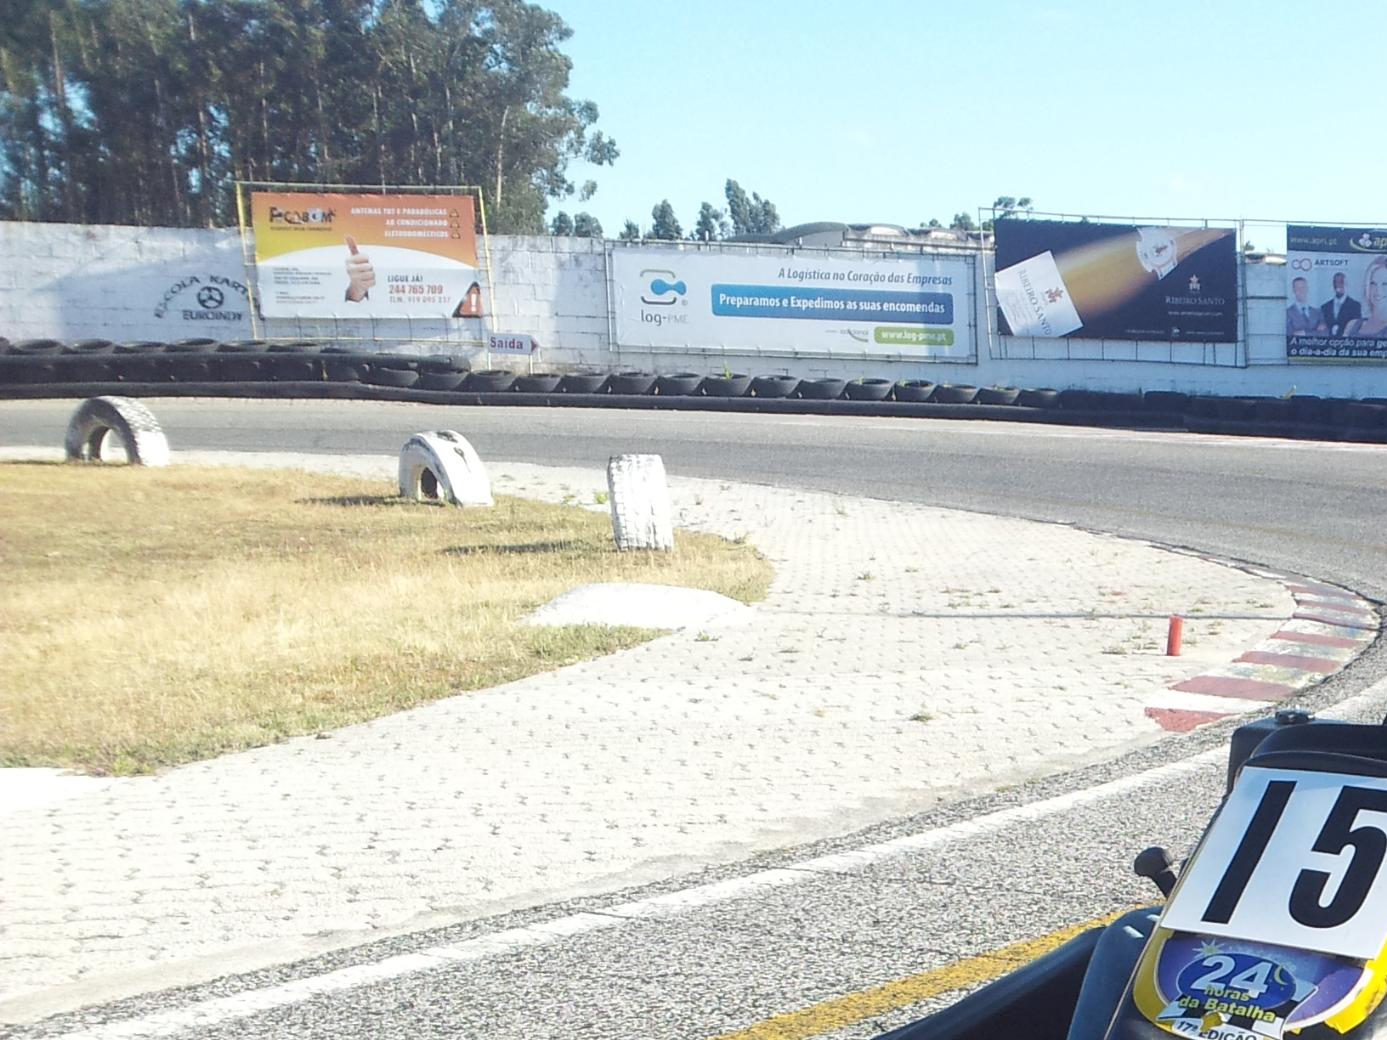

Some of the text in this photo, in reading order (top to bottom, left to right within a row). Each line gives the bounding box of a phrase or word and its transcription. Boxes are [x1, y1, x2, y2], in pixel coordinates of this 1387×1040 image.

[778, 267, 952, 287] A Logística no Coração das Empresas
[154, 275, 201, 319] ESCOLA
[388, 284, 406, 294] 244
[719, 293, 945, 314] Preparamos e Expedimos as suas encomendas
[182, 309, 242, 320] EUROINDY
[1289, 337, 1298, 345] A
[1299, 337, 1328, 346] melhor
[1329, 337, 1355, 347] opção
[1356, 339, 1375, 347] para
[1299, 347, 1337, 356] dia-a-dia
[1339, 348, 1350, 356] da
[1190, 955, 1273, 999] 24
[1204, 985, 1251, 1001] horas
[1178, 996, 1276, 1022] da Batalha
[1177, 1020, 1199, 1032] 17ª
